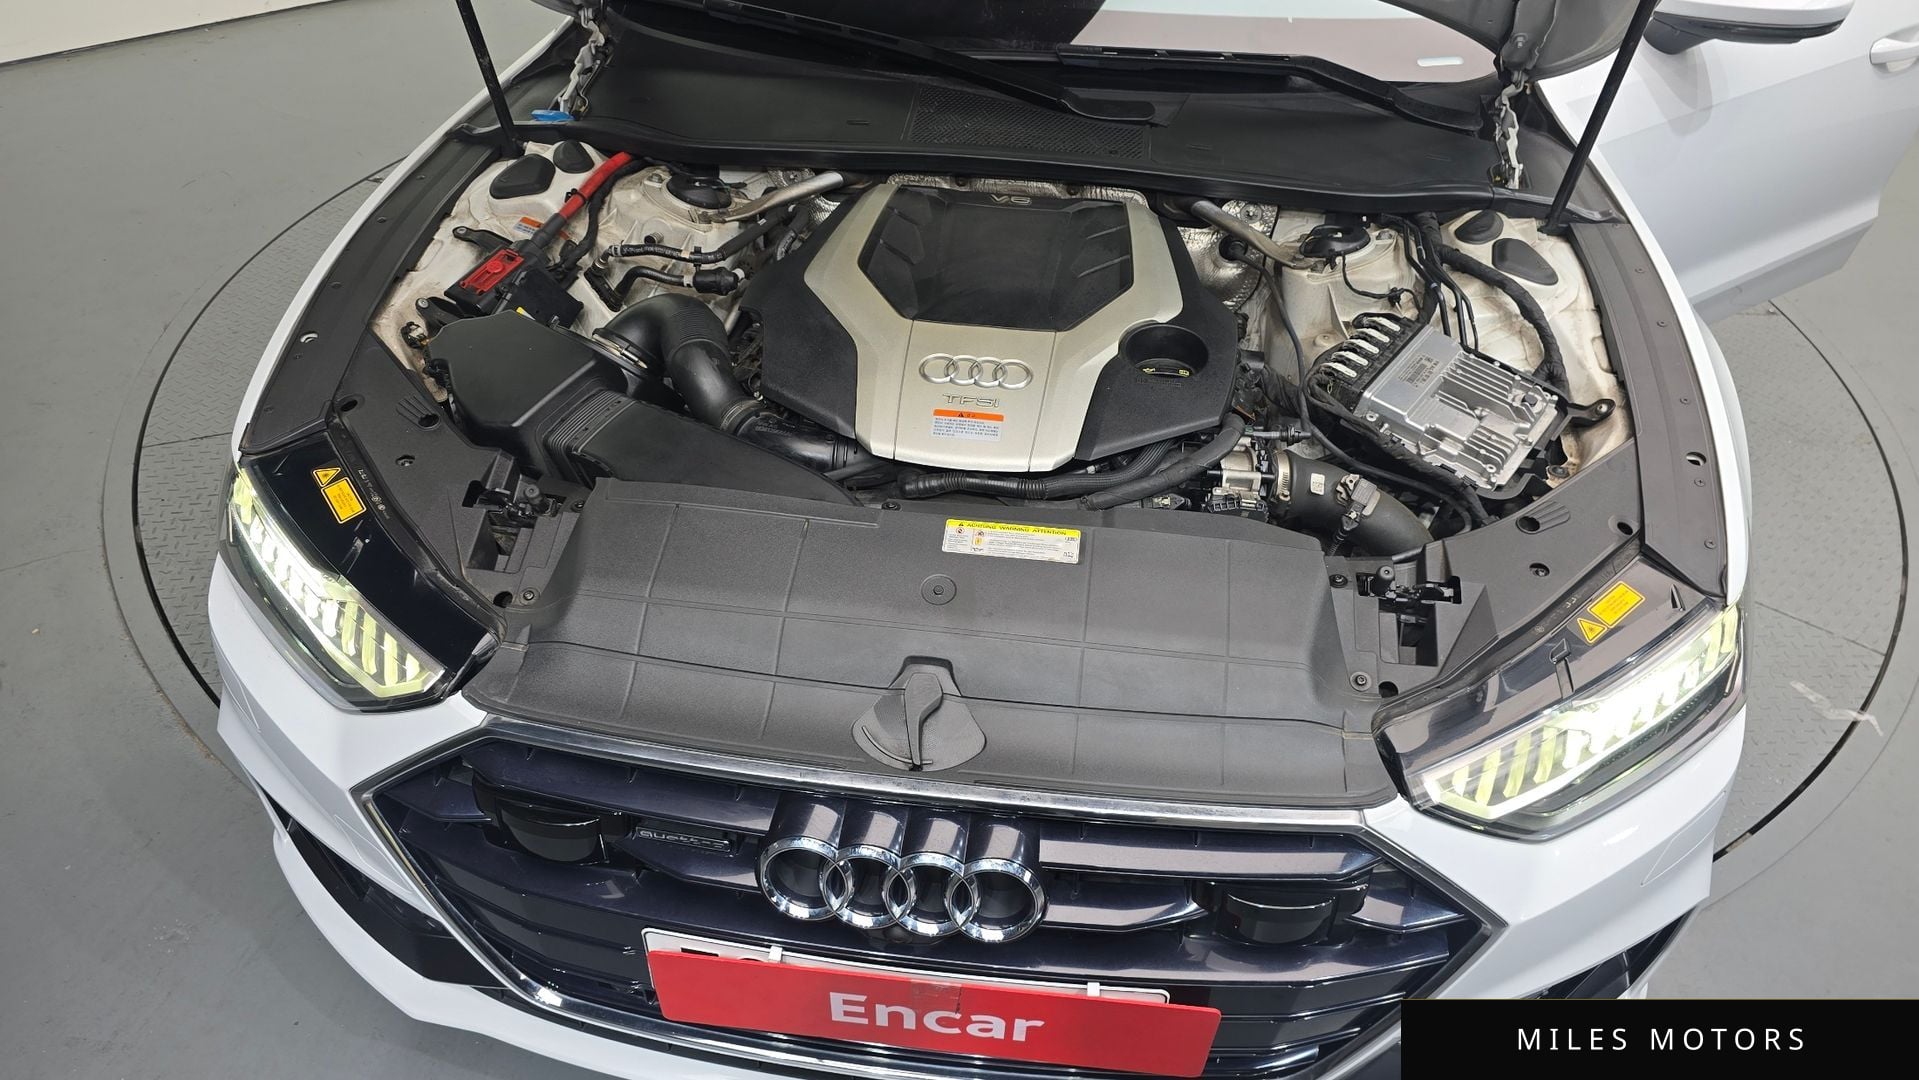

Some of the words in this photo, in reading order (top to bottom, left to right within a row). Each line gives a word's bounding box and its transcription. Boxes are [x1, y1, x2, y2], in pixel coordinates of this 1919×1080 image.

[990, 194, 1031, 204] V6
[943, 393, 999, 408] TFSI
[967, 522, 997, 531] ACHTUNG
[1000, 525, 1030, 533] WARNING
[1032, 528, 1067, 536] ATTENTION
[829, 991, 1045, 1042] Encar
